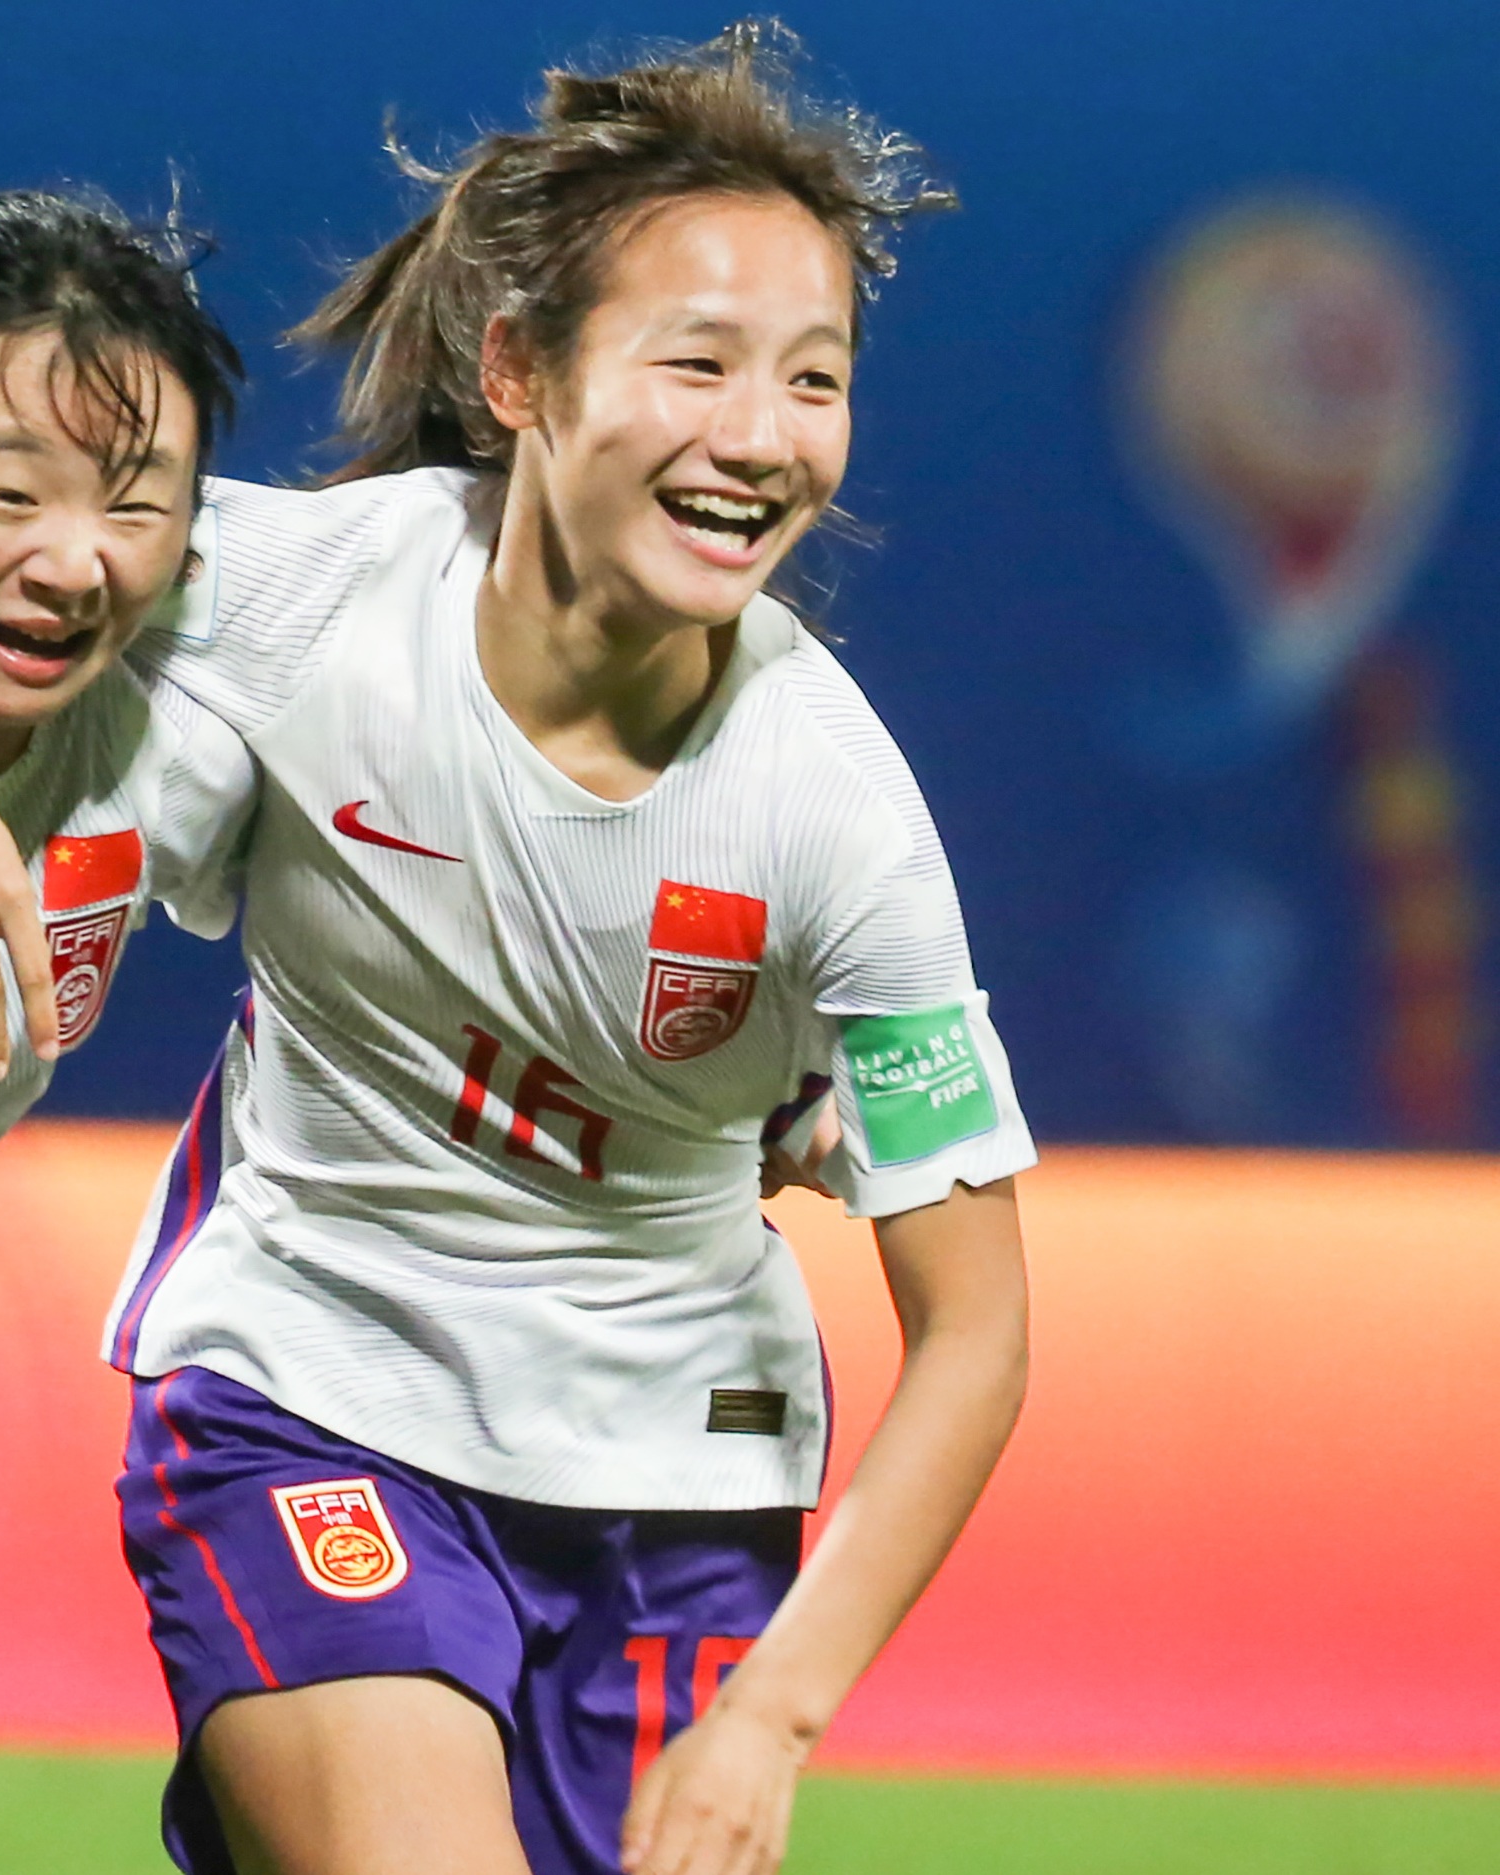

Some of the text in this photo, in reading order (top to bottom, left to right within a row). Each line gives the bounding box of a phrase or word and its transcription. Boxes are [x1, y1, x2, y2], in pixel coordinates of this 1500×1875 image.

[54, 921, 114, 957] CFA
[662, 973, 740, 994] CFA
[854, 1024, 964, 1071] LIVING
[857, 1042, 970, 1086] FOOTBALL
[451, 1022, 615, 1182] 16
[929, 1073, 980, 1109] FIFA
[290, 1491, 369, 1519] CFA
